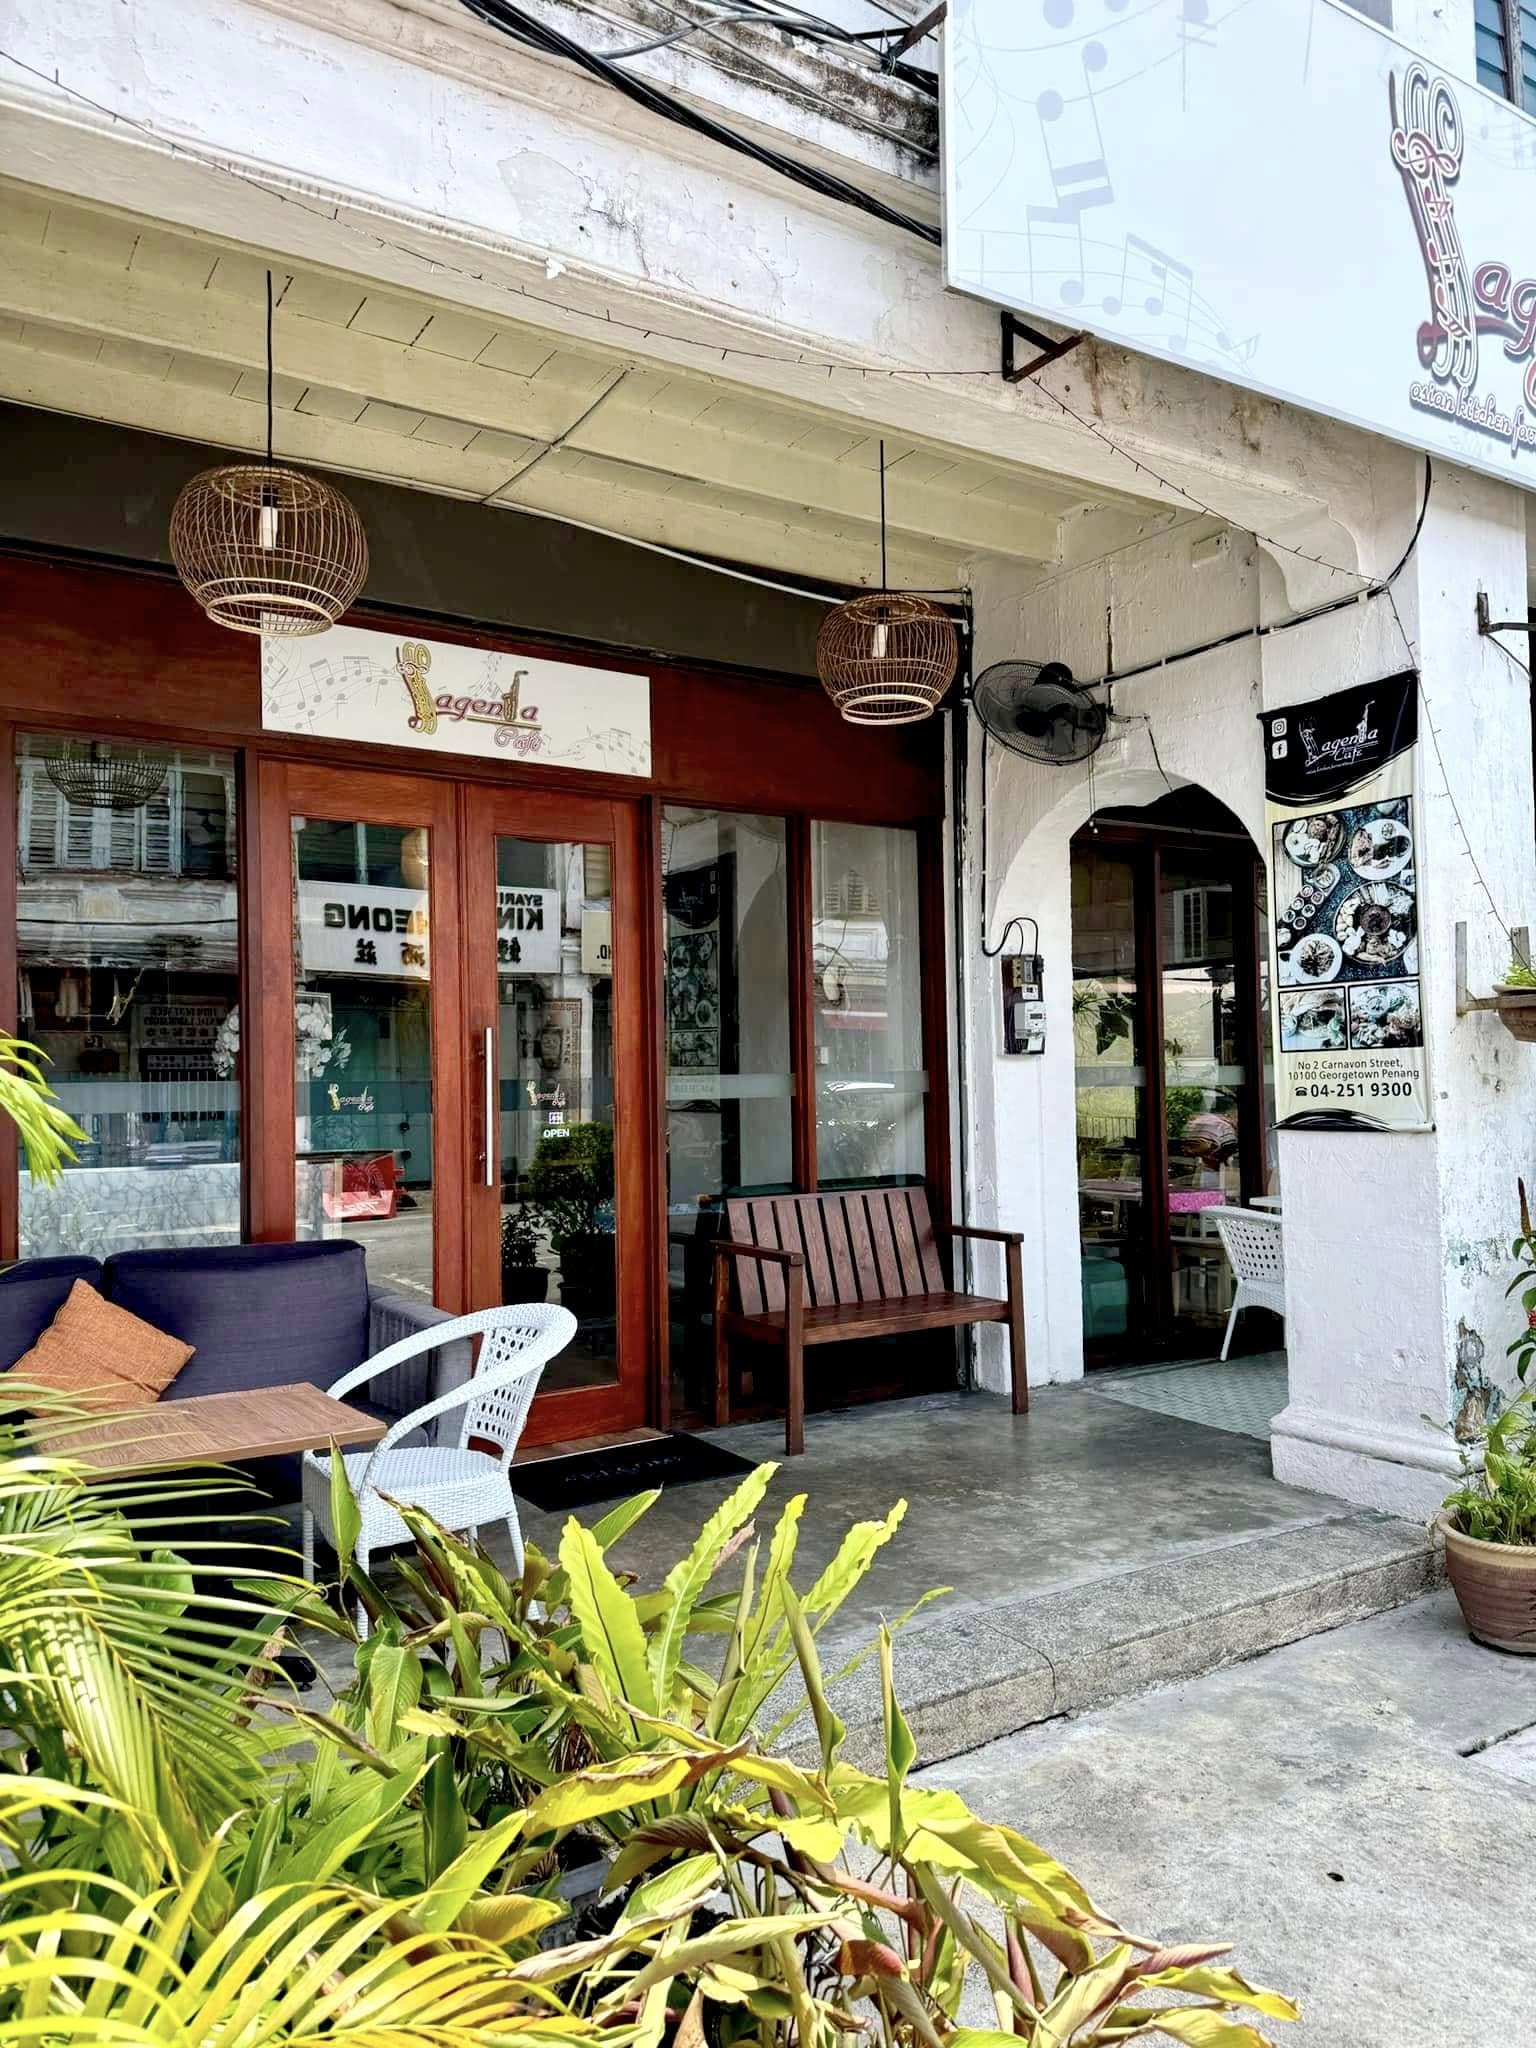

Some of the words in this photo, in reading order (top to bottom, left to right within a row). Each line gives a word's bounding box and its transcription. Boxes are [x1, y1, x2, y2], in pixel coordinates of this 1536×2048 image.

[1410, 382, 1455, 414] asian
[1456, 386, 1512, 436] kitchen
[1298, 1061, 1311, 1070] No
[1313, 1061, 1319, 1070] 2
[1321, 1060, 1367, 1070] Carnavon
[1370, 1058, 1403, 1068] Street,
[1288, 1071, 1317, 1081] 10100
[1319, 1070, 1380, 1081] Georgetown
[1382, 1069, 1420, 1080] Penang
[1311, 1083, 1364, 1097] 04-251
[1371, 1082, 1412, 1097] 9300
[543, 1128, 570, 1138] OPEN
